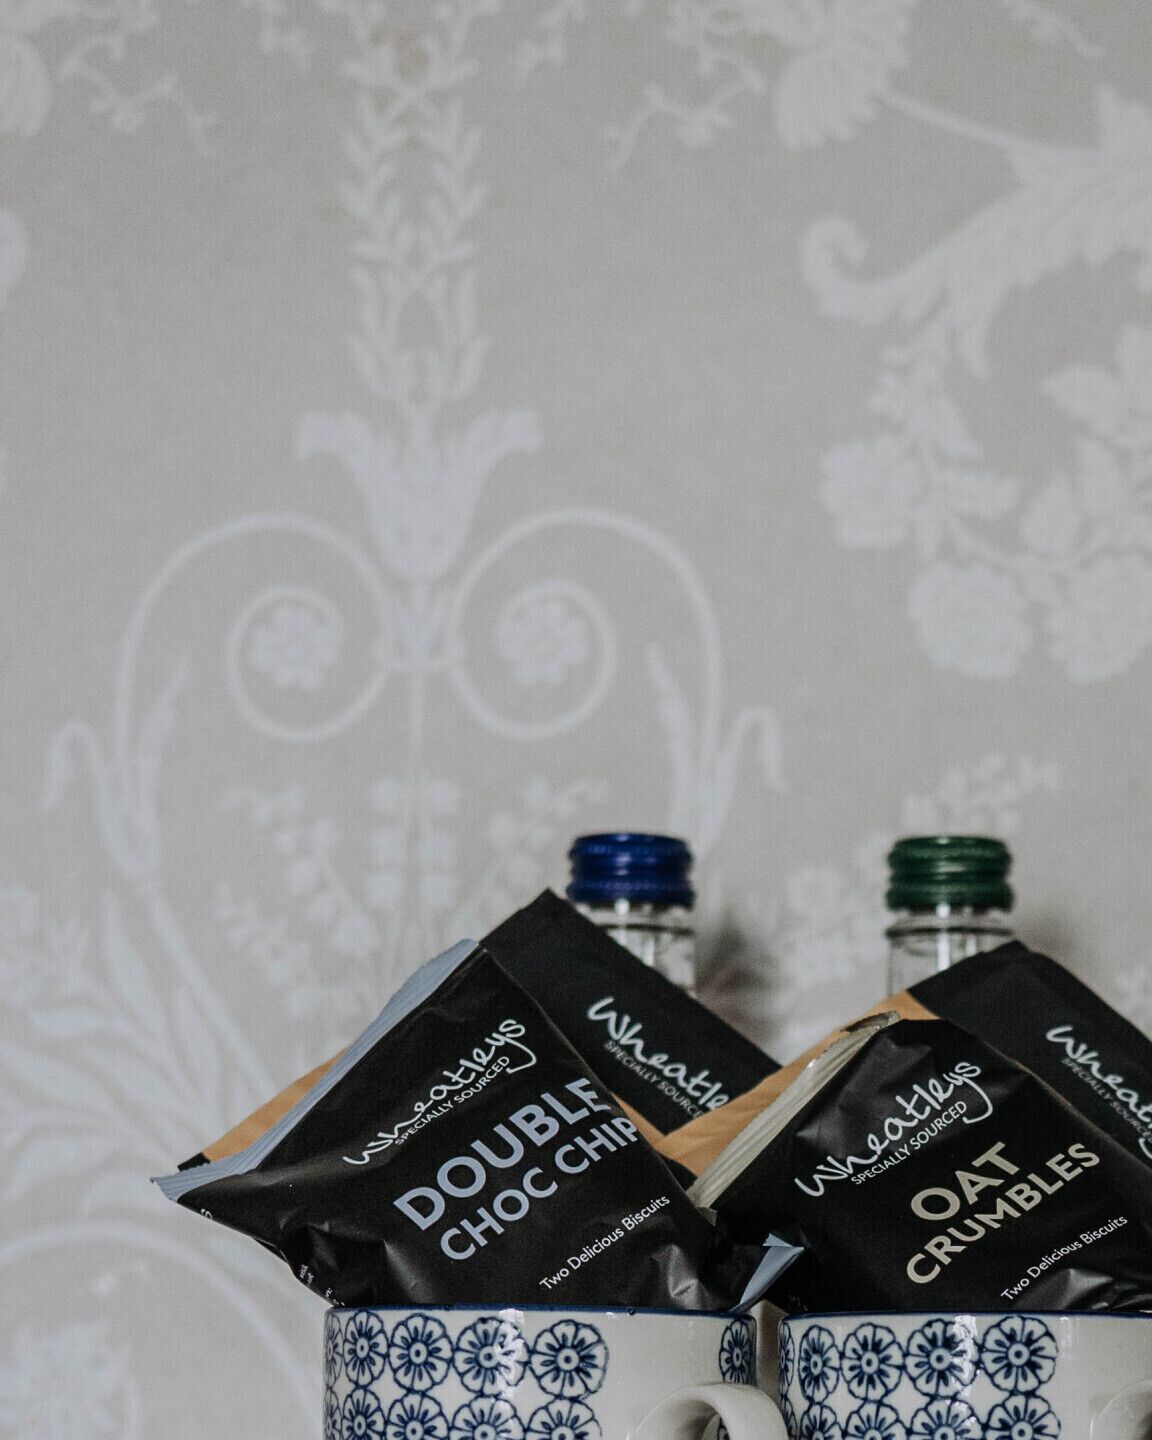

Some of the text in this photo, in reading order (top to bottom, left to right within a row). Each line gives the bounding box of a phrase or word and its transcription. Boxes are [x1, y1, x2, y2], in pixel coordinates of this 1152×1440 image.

[342, 1018, 537, 1165] Wheatleys
[395, 1055, 511, 1147] SPECIALLY SOURCED
[794, 1060, 994, 1198] Wheatleys
[851, 1100, 968, 1185] SPECIALLY SOURCED
[393, 1076, 612, 1231] DOUBLE
[440, 1116, 638, 1261] CHOC CHIP
[910, 1141, 1020, 1221] OAT
[539, 1196, 671, 1290] Two Delicious Biscuits
[906, 1142, 1100, 1284] CRUMBLES
[1000, 1216, 1128, 1301] Two Delicious Biscuits
